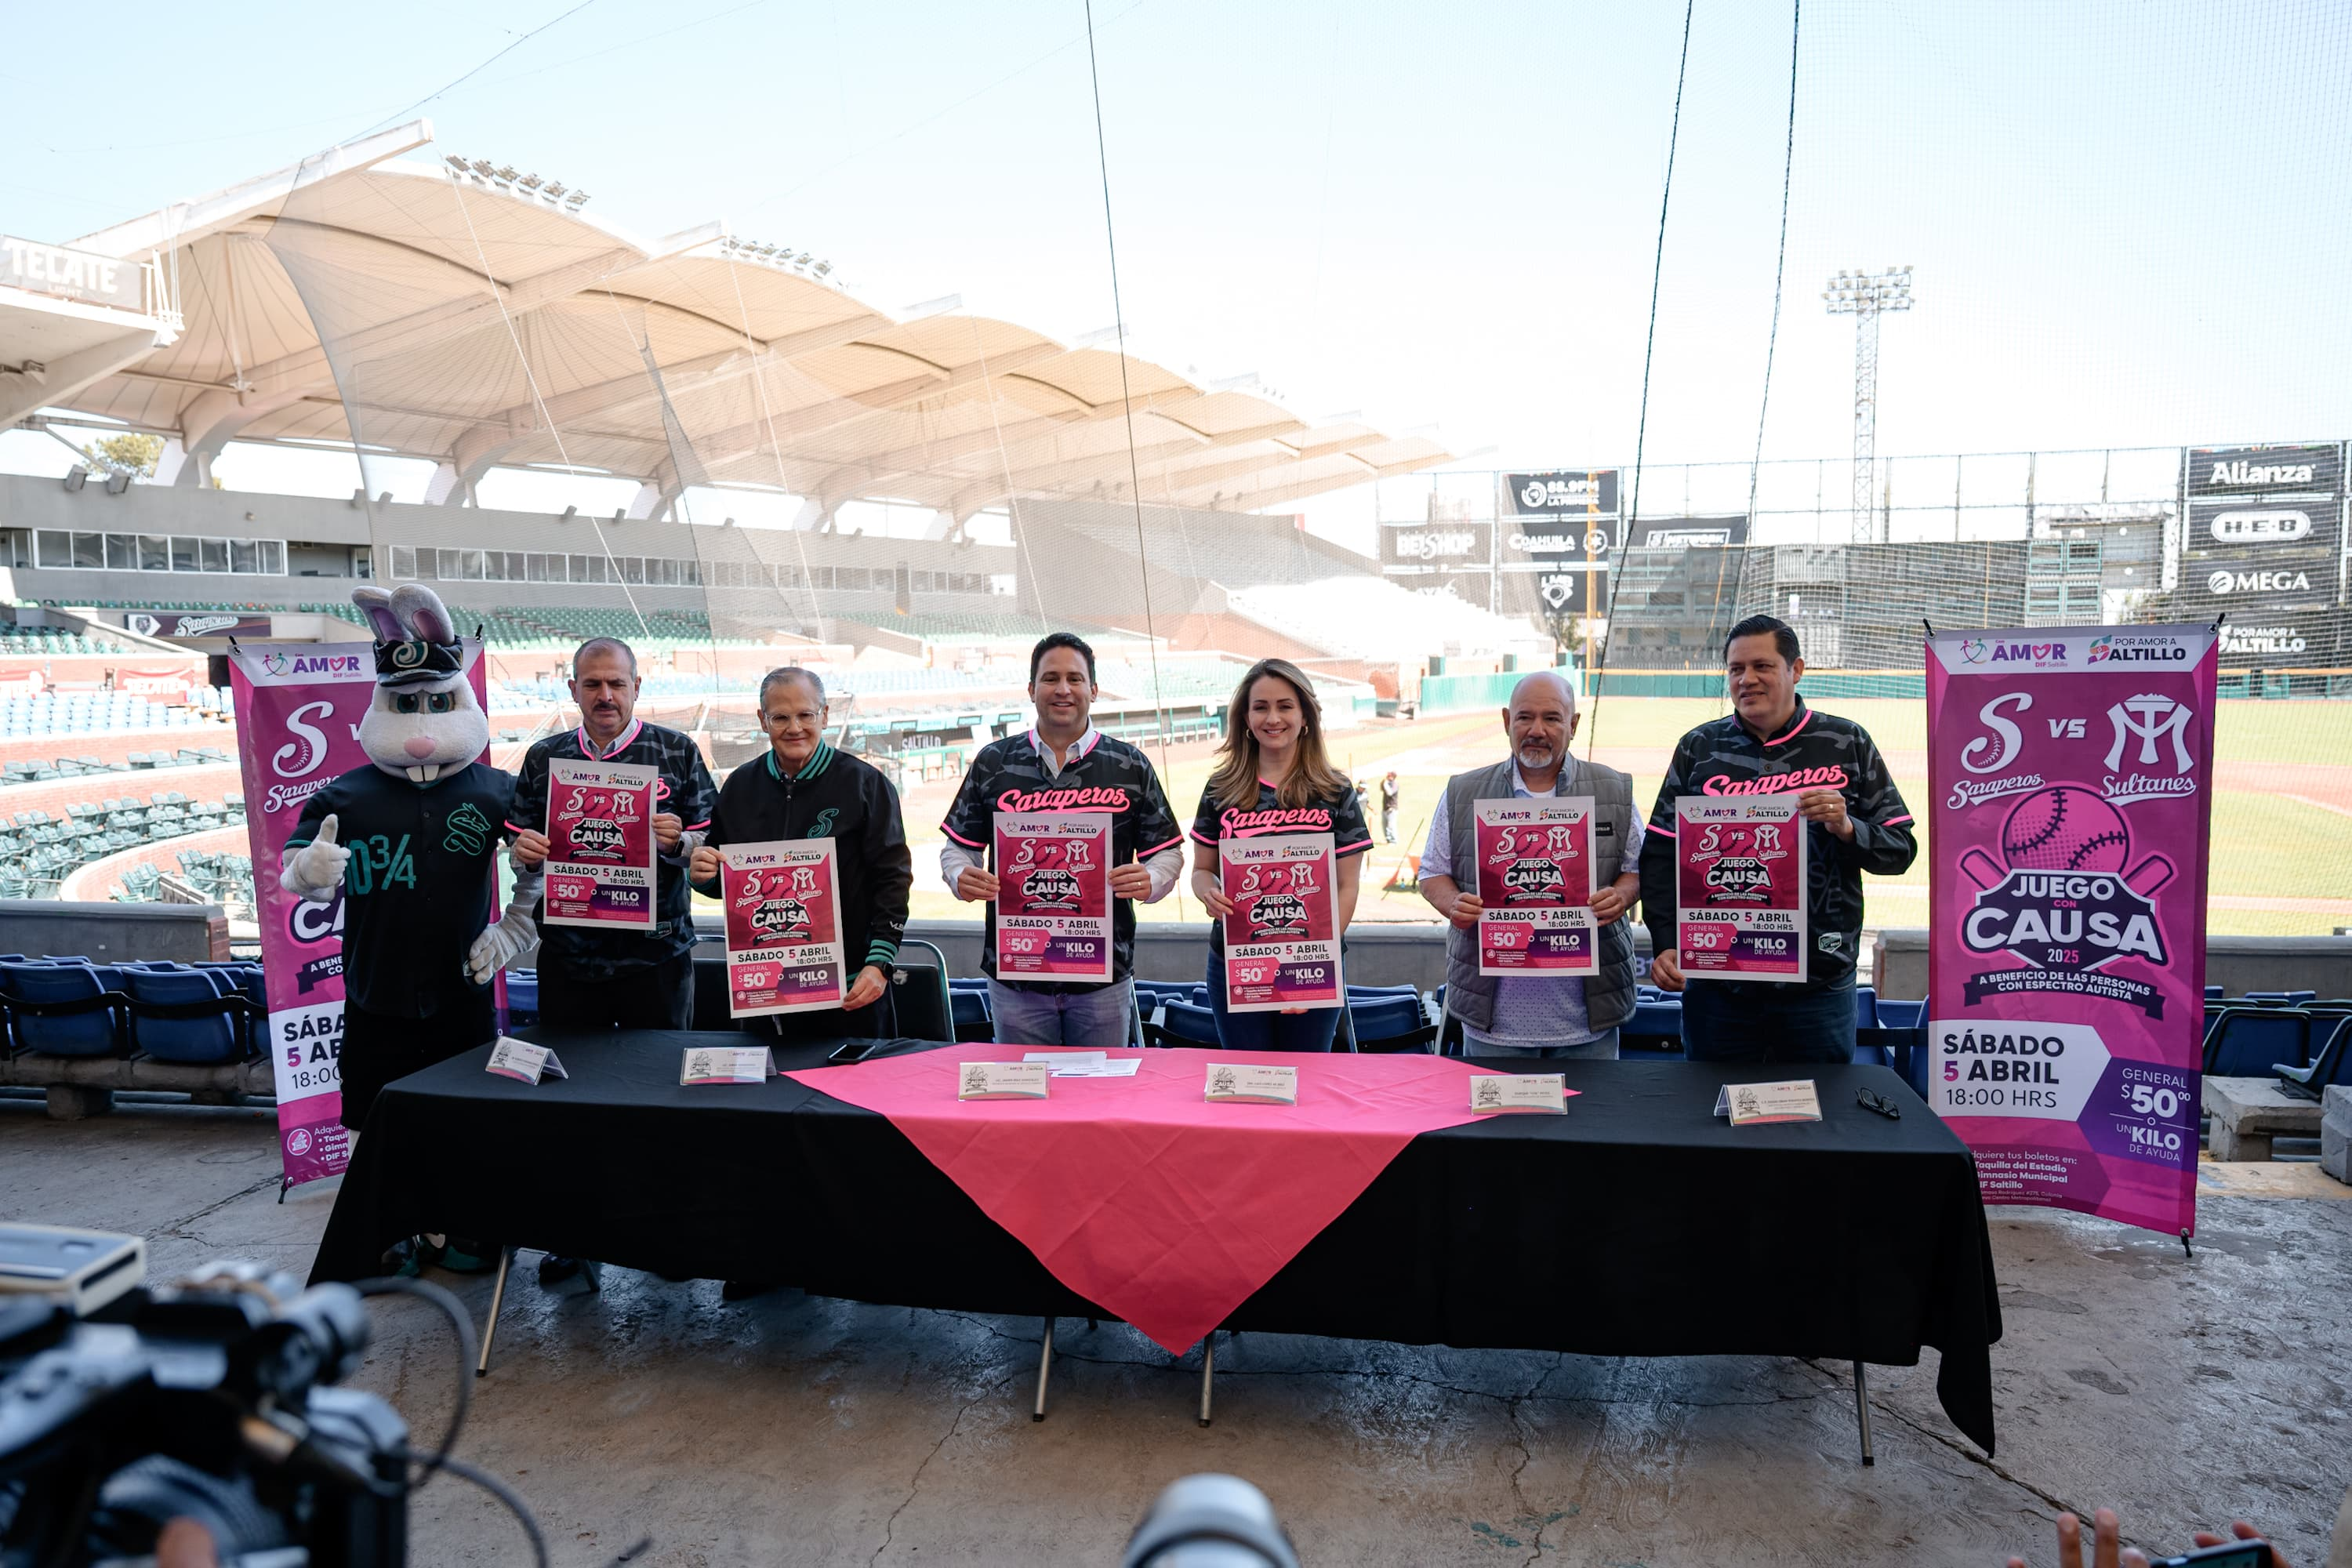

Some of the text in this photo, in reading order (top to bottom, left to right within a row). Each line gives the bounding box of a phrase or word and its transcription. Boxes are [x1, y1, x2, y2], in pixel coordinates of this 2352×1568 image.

[2, 237, 119, 294] TECATE
[2209, 461, 2313, 485] Alianza
[1508, 533, 1576, 549] COAHUILA
[2235, 572, 2310, 590] MEGA
[2234, 628, 2252, 637] POR
[2253, 627, 2285, 637] AMOR
[902, 735, 941, 750] SALTILLO
[1702, 764, 1849, 797] Saraperos
[1947, 773, 2045, 810] Saraperos
[2100, 773, 2196, 806] Sultanes
[996, 786, 1131, 814] Saraperos
[583, 821, 612, 829] JUEGO
[1220, 808, 1332, 839] Saraperos
[570, 830, 626, 848] CAUSA
[1517, 860, 1548, 869] JUEGO
[1721, 859, 1755, 868] JUEGO
[554, 865, 644, 878] SÁBADO 5 ABRIL
[1504, 871, 1565, 886] CAUSA
[1706, 870, 1772, 887] CAUSA
[1022, 881, 1081, 897] CAUSA
[2011, 876, 2114, 899] JUEGO
[611, 891, 639, 902] KILO
[1262, 896, 1293, 905] JUEGO
[764, 901, 794, 910] JUEGO
[751, 911, 811, 928] CAUSA
[1250, 906, 1308, 924] CAUSA
[1489, 910, 1536, 920] SÁBADO
[1541, 912, 1548, 920] 5
[1689, 910, 1791, 923] SÁBADO 5 ABRIL
[1007, 917, 1099, 929] SÁBADO 5 ABRIL
[1550, 935, 1580, 946] KILO
[1967, 907, 2164, 962] CAUSA
[1065, 942, 1095, 953] KILO
[1236, 945, 1328, 957] SÁBADO 5 ABRIL
[1754, 938, 1787, 949] KILO
[738, 947, 830, 963] SÁBADO 5 ABRIL
[2047, 949, 2079, 964] 2025
[798, 971, 828, 982] KILO
[1295, 967, 1324, 978] KILO
[1989, 971, 2047, 983] BENEFICIO
[2049, 971, 2065, 981] DE
[2067, 973, 2088, 982] LAS
[2090, 975, 2151, 996] PERSONAS
[1998, 981, 2132, 1000] CON ESPECTRO AUTISTA
[1943, 1029, 2064, 1057] SÁBADO
[287, 1047, 301, 1067] 5
[1944, 1060, 2060, 1084] 5 ABRIL
[2122, 1068, 2187, 1088] GENERAL
[1947, 1089, 2056, 1108] 18:00 HRS
[2147, 1117, 2156, 1126] O
[2117, 1123, 2180, 1149] UN KILO
[325, 1152, 340, 1161] DIF
[2024, 1151, 2060, 1162] boletos
[2129, 1144, 2180, 1163] DE AYUDA
[2013, 1161, 2027, 1170] del
[2029, 1163, 2067, 1173] Estadio
[1990, 1181, 2023, 1189] Saltillo
[2020, 1172, 2068, 1183] Municipal
